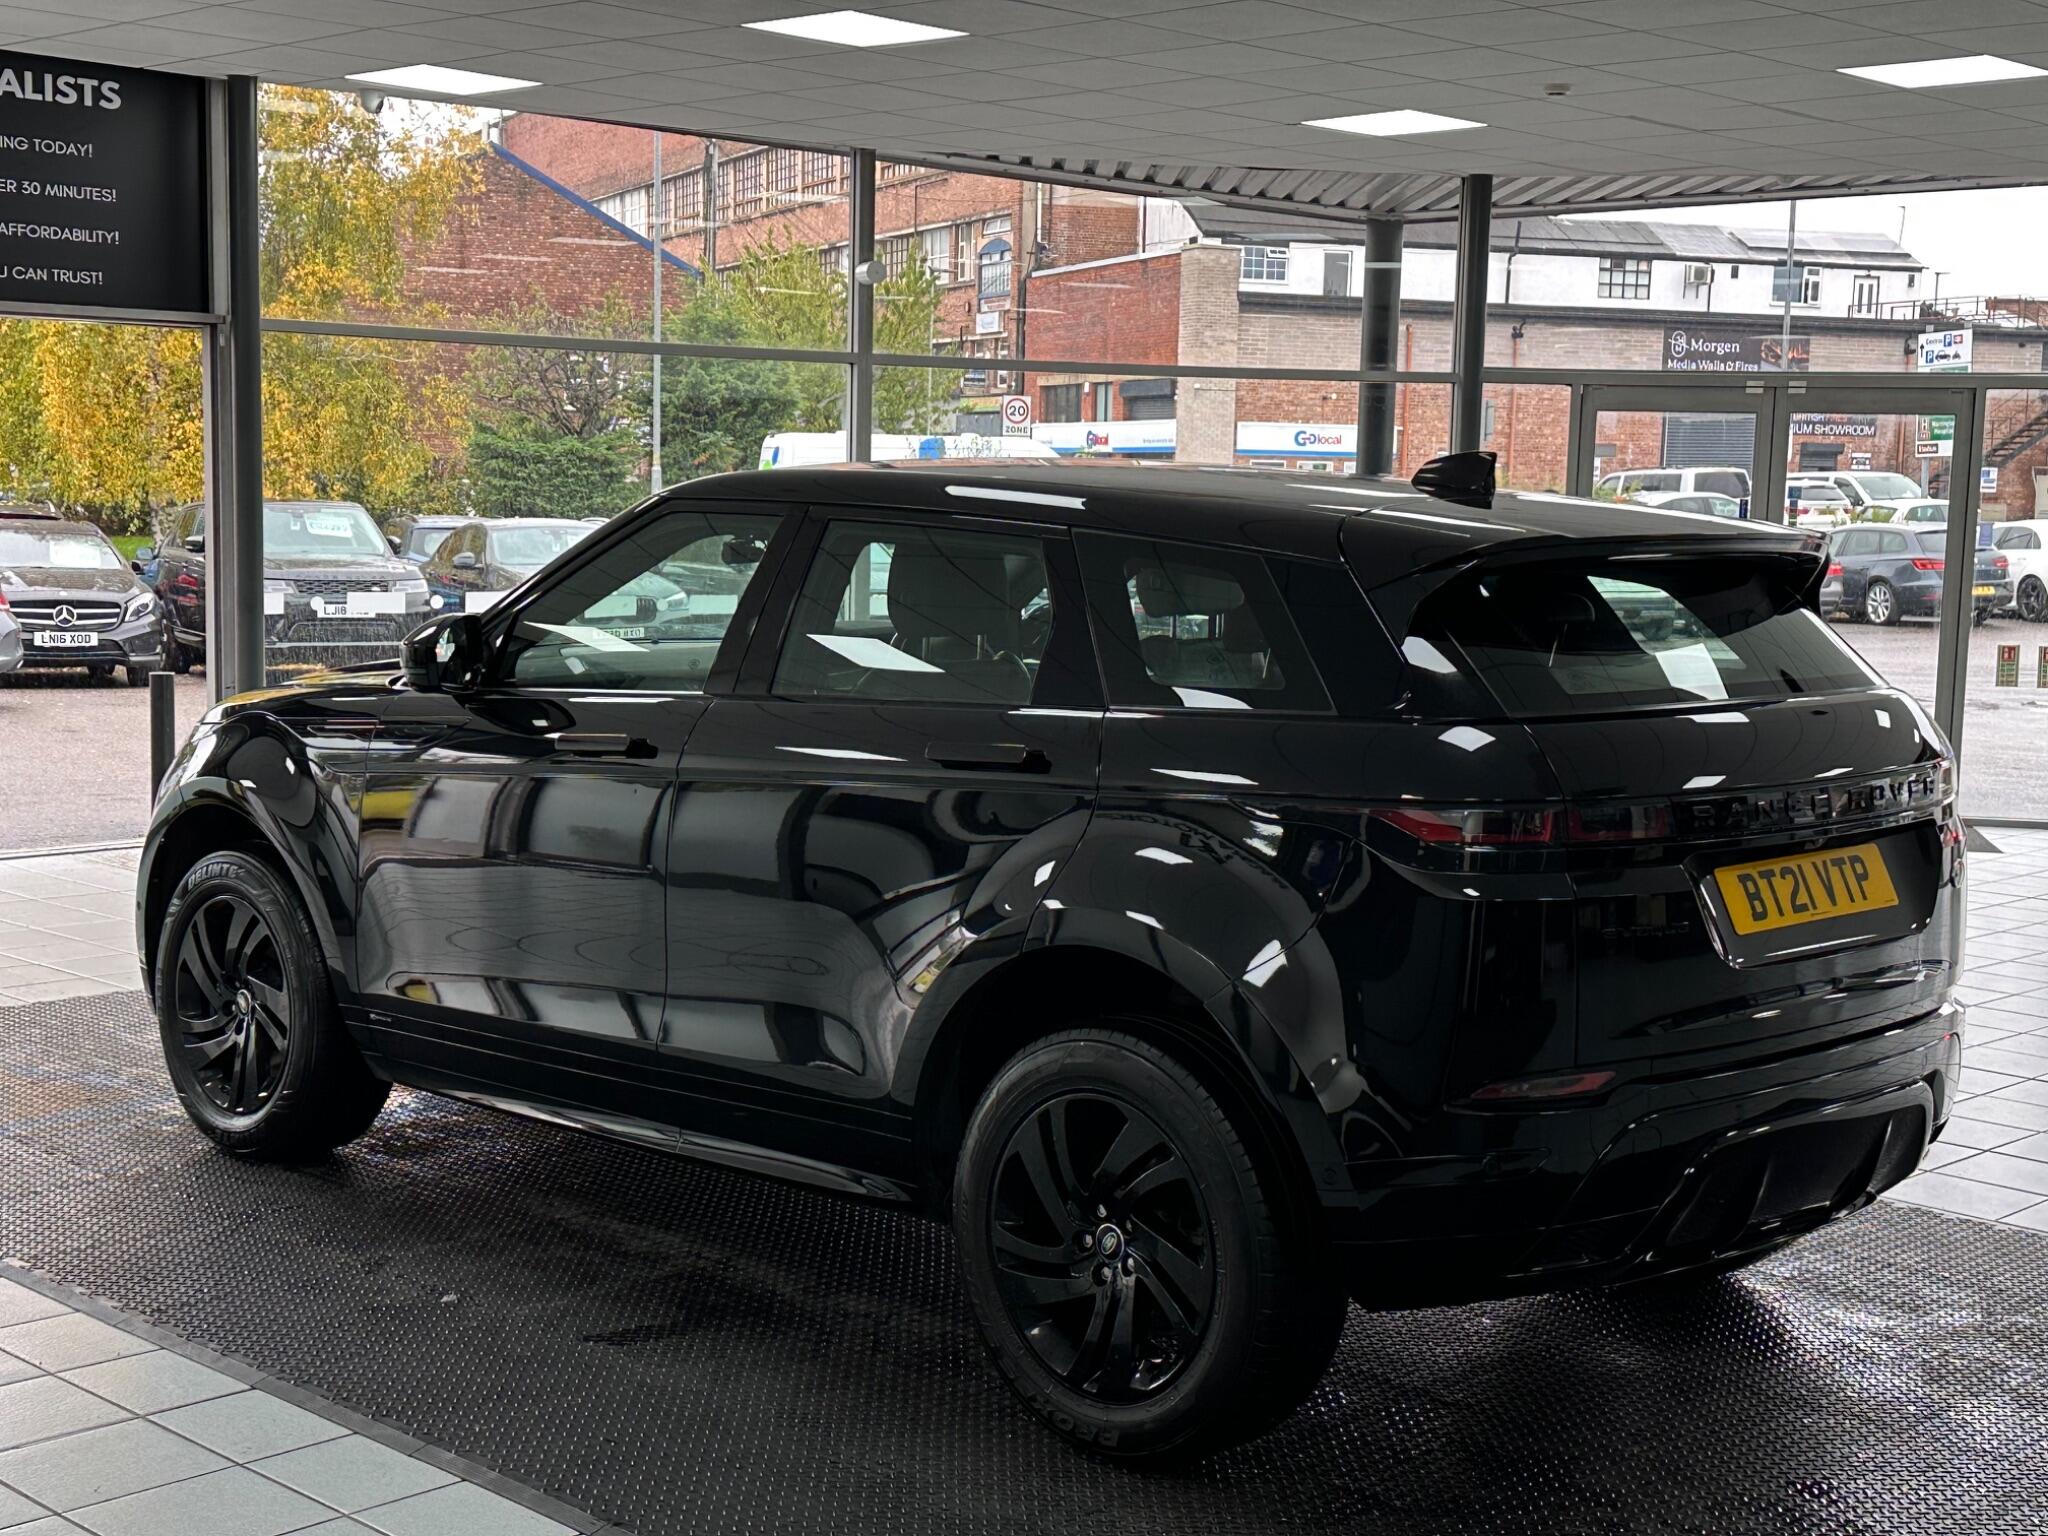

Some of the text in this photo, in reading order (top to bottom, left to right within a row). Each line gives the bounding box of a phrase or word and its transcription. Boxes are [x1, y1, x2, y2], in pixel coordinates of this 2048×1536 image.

[0, 68, 122, 110] ALISTS
[33, 138, 93, 158] TODAY!
[21, 181, 41, 195] 30
[45, 183, 117, 202] MINUTES!
[0, 222, 120, 245] AFFORDABILITY!
[12, 266, 48, 281] CAN
[51, 269, 103, 285] TRUST!
[1690, 338, 1740, 355] Morgen
[1667, 358, 1697, 369] Media
[1698, 359, 1725, 371] Walls
[1736, 361, 1758, 371] Fires
[1008, 405, 1026, 417] 20
[1005, 426, 1029, 434] ZONE
[1814, 424, 1875, 436] SHOWROOM
[41, 634, 92, 644] LN16 XOD
[1737, 854, 1870, 922] BT21 VTP
